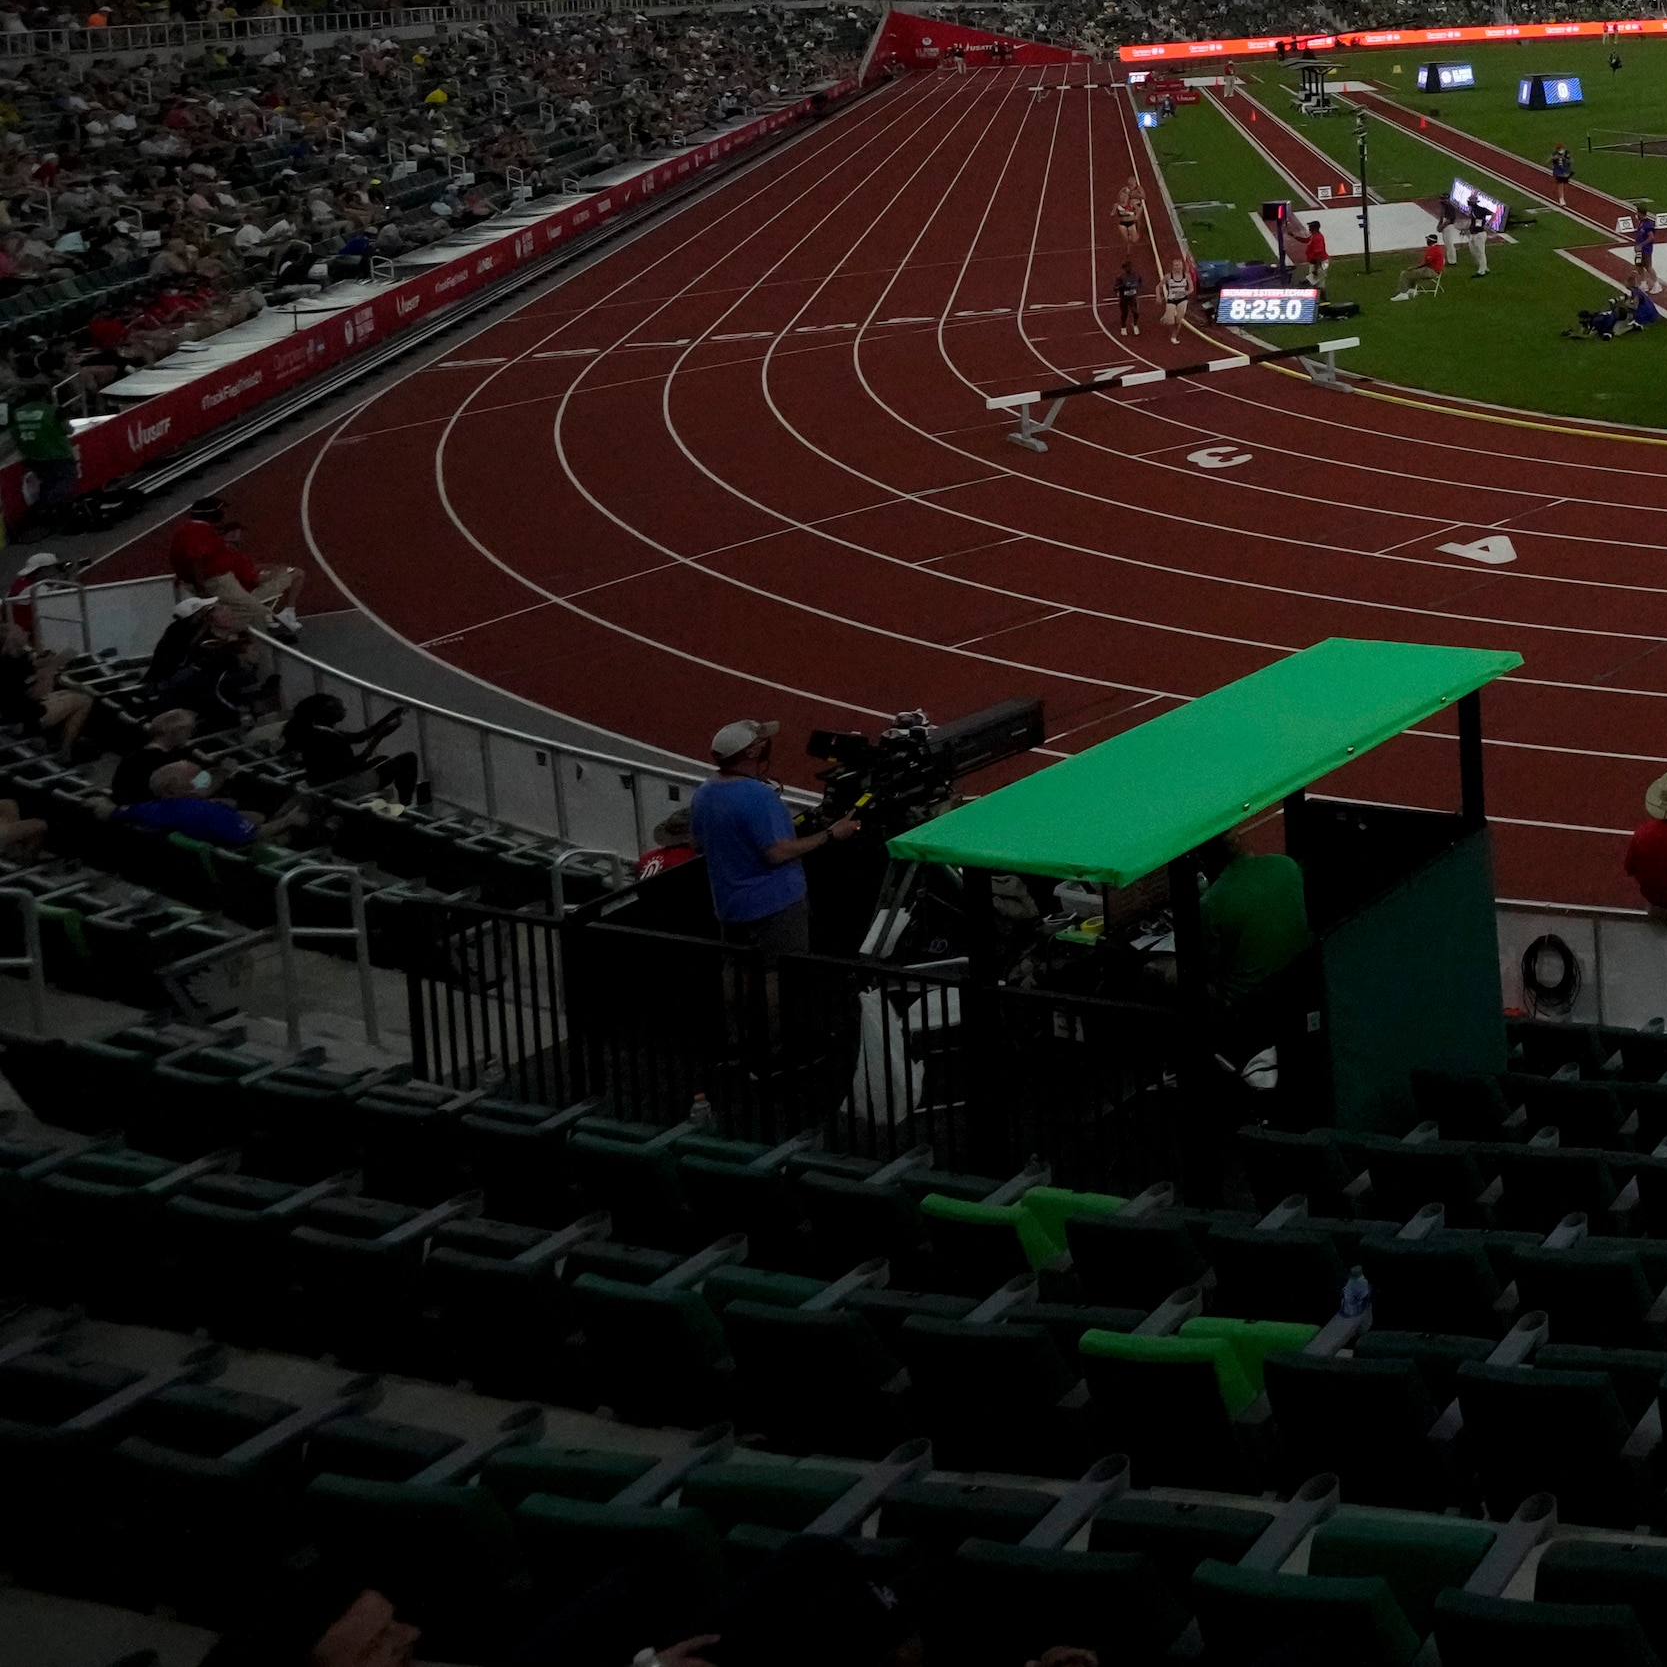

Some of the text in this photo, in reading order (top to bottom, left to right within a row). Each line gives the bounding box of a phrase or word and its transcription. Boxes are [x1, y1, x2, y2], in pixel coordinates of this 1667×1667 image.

[1229, 299, 1302, 320] 8:25.0
[1187, 445, 1253, 469] 3
[1434, 535, 1518, 565] 4
